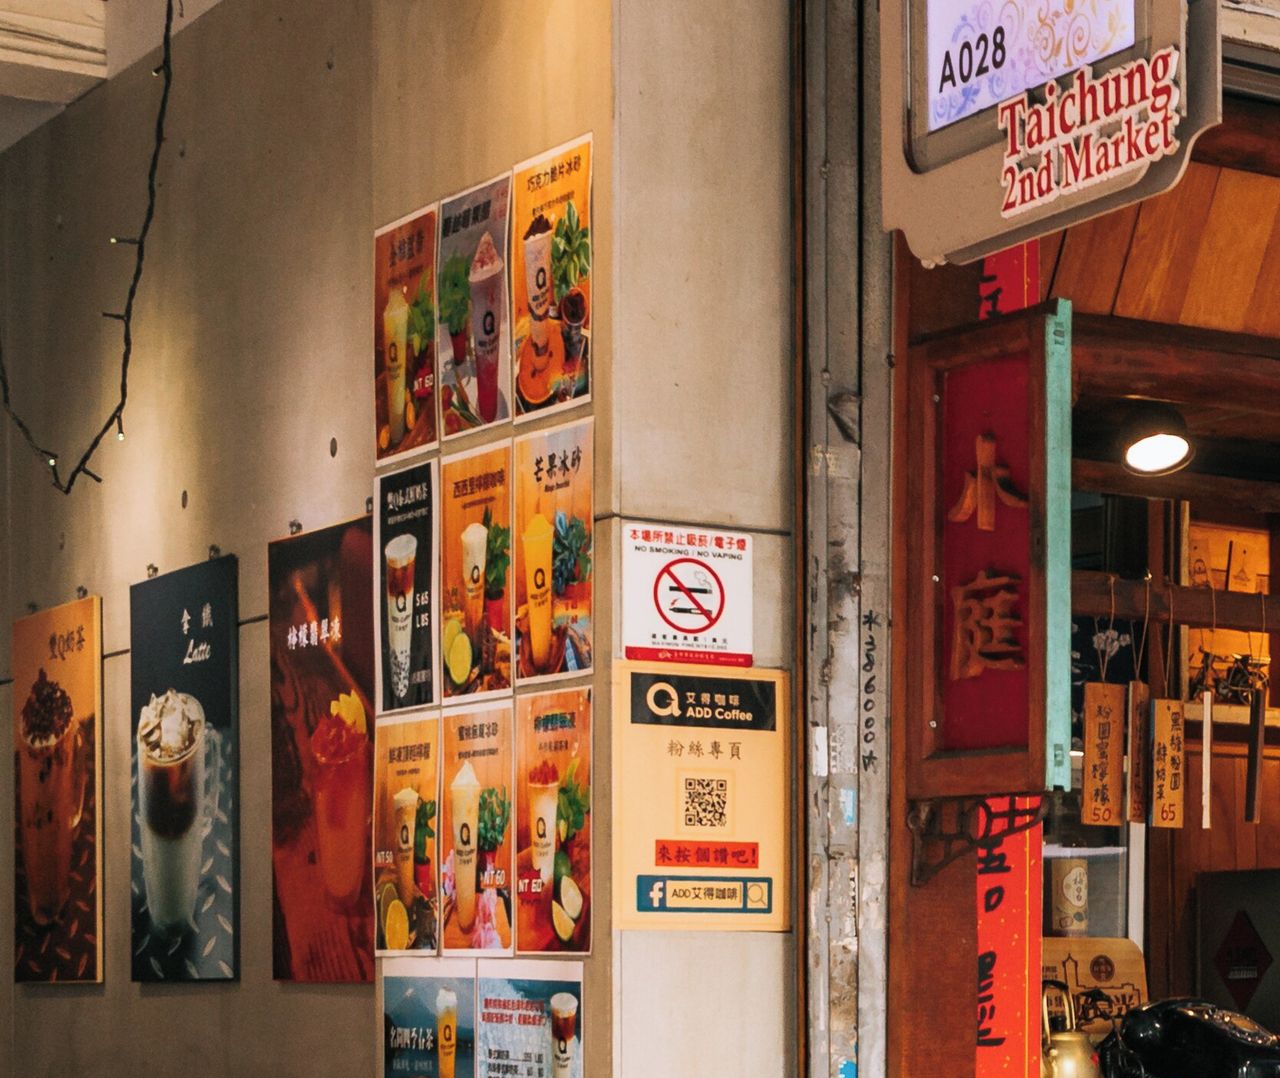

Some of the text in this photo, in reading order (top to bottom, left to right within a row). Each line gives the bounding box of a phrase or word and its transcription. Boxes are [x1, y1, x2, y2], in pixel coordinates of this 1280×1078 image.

[938, 25, 1007, 94] A028
[1001, 50, 1175, 158] Taichung
[1002, 113, 1175, 213] 2nd Market
[650, 546, 689, 556] SMOKING
[711, 551, 743, 560] VAPING
[948, 431, 1029, 680] 小庭
[183, 639, 212, 665] Latte
[686, 707, 753, 721] ADD Coffee
[666, 739, 742, 761] 粉絲專頁
[1092, 807, 1112, 822] 50
[1160, 803, 1176, 821] 65
